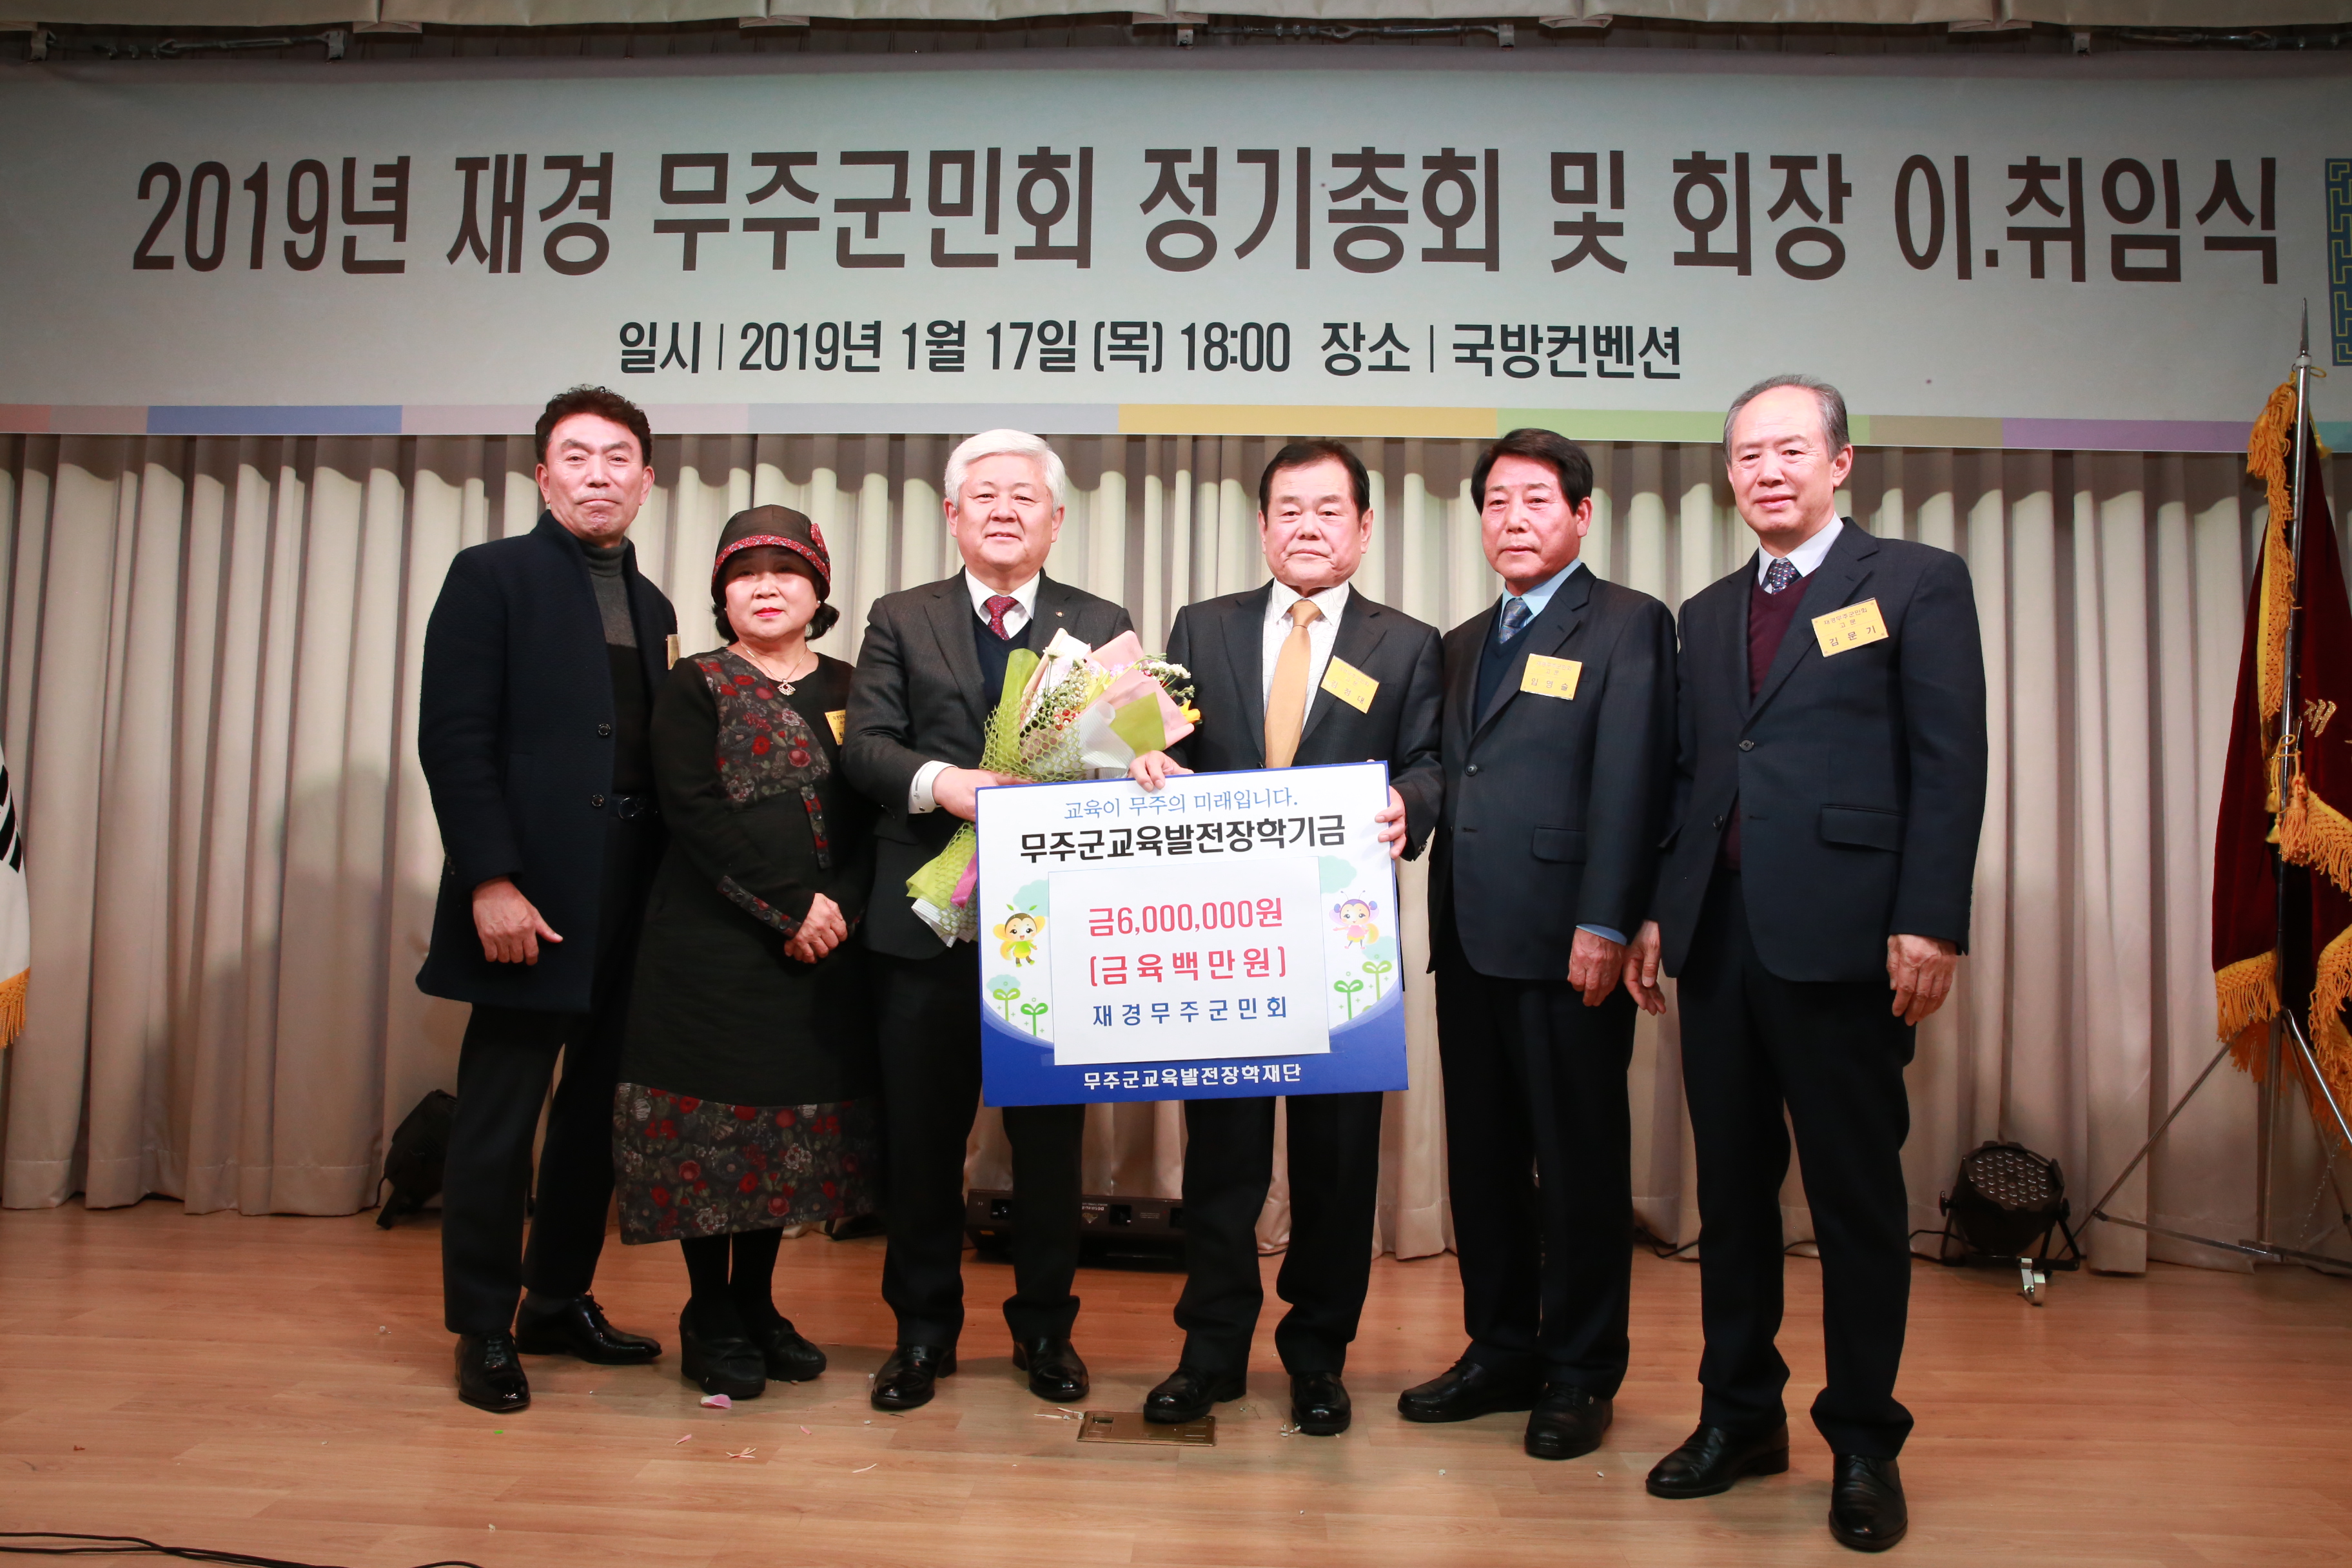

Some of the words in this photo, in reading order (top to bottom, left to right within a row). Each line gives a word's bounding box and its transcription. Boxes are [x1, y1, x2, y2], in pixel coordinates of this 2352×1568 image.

[132, 155, 411, 275] 2019년
[446, 152, 614, 276] 재경
[653, 146, 1094, 271] 무주군민회
[1139, 146, 1500, 273] 정기총회
[1550, 150, 1628, 275] 및
[1672, 150, 1852, 280] 회장
[1894, 153, 2278, 284] 이.취임식
[619, 321, 701, 374] 일시
[739, 320, 882, 373] 2019년
[901, 320, 966, 373] 1월
[986, 320, 1077, 373] 17일
[1181, 322, 1291, 372] 18:00
[1320, 322, 1411, 377] 장소
[1452, 324, 1681, 380] 국방컨벤션
[1064, 798, 1121, 819] 교육이
[1128, 793, 1186, 817] 무주의
[1193, 787, 1298, 812] 미래입니다.
[1020, 814, 1346, 864] 무주군교육발전장학기금
[1088, 897, 1283, 937] 금6,000,000원
[1083, 1063, 1302, 1090] 무주군교육발전장학재단
